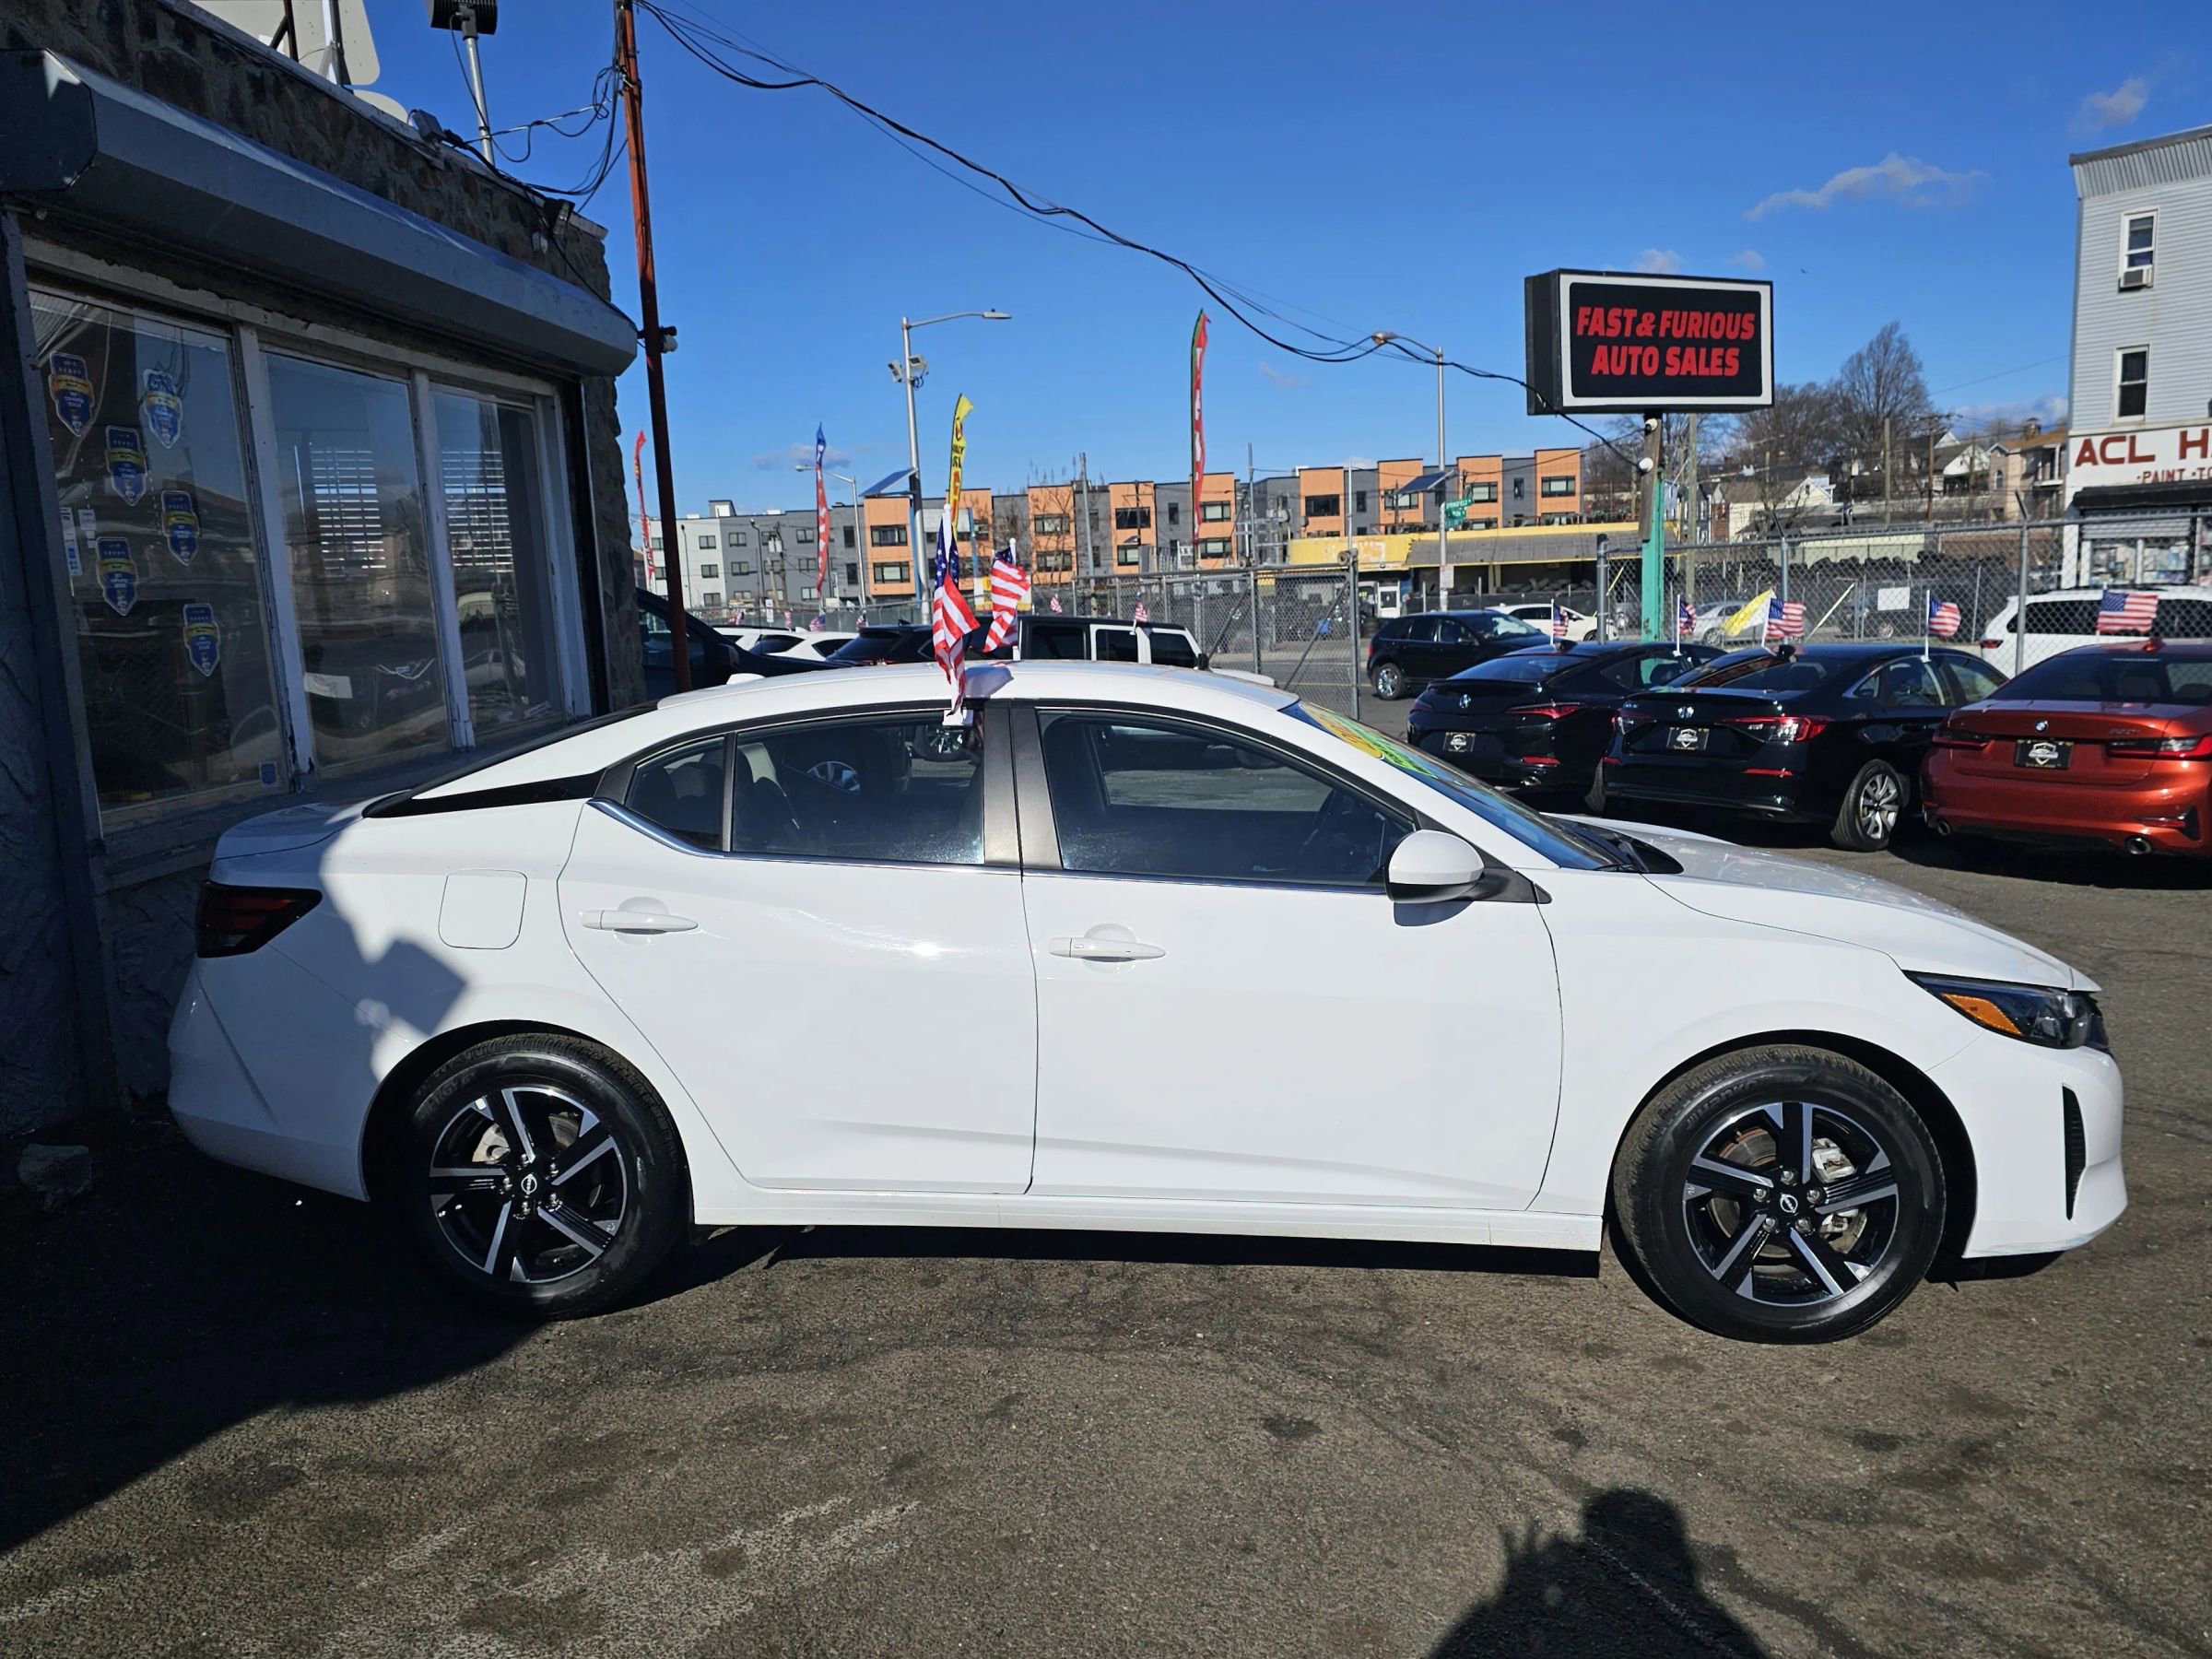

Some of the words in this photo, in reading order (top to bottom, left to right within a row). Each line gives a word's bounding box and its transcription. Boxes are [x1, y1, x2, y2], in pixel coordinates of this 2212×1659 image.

[1576, 306, 1637, 337] FAST
[1636, 312, 1656, 337] &
[1658, 310, 1756, 340] FURIOUS
[1591, 345, 1659, 376] AUTO
[1665, 347, 1740, 377] SALES
[2075, 435, 2156, 467] ACL
[2179, 428, 2210, 460] H
